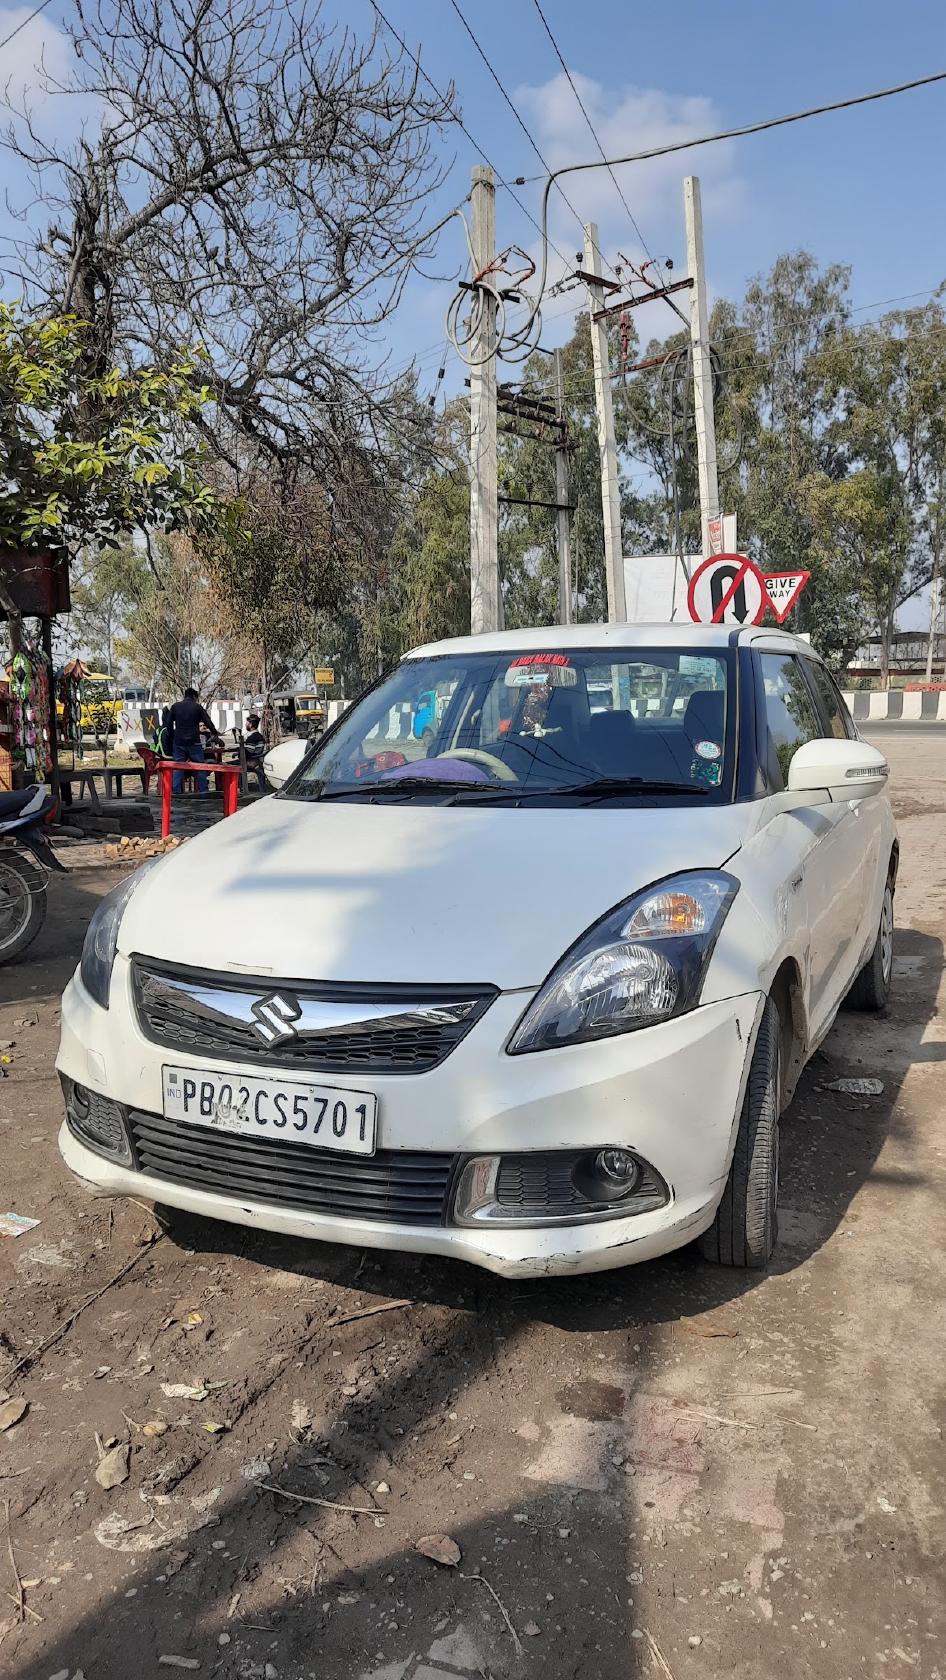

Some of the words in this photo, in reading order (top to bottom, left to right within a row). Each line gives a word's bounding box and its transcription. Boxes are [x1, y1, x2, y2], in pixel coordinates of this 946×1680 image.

[765, 578, 796, 590] GIVE
[769, 590, 791, 598] WAY
[183, 1078, 368, 1142] PB02CS5701
